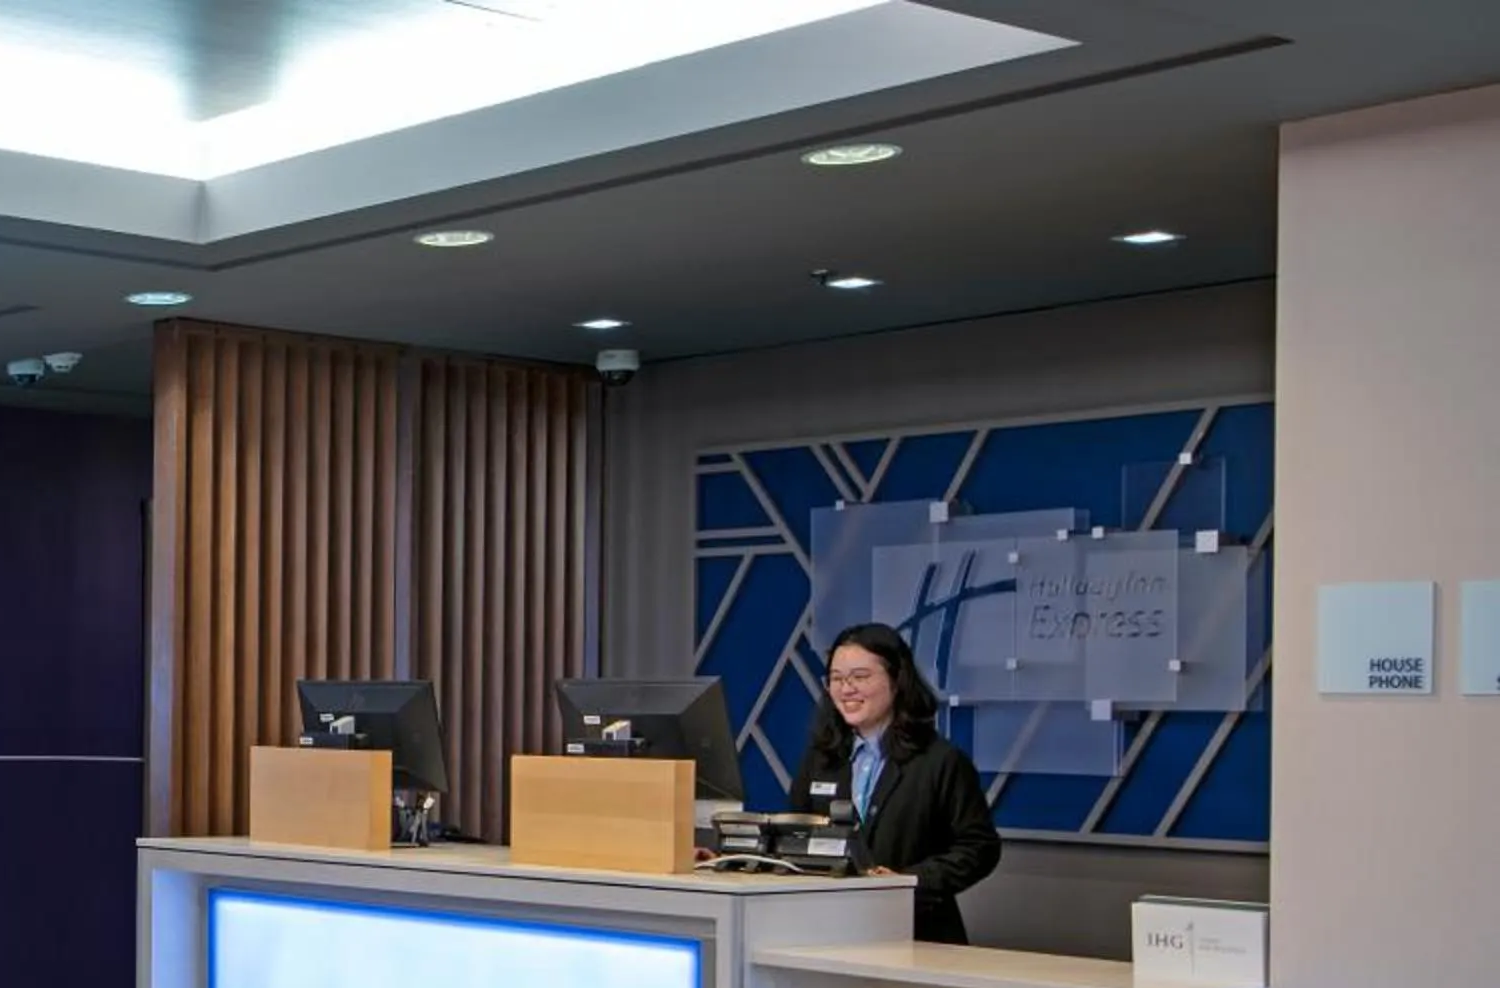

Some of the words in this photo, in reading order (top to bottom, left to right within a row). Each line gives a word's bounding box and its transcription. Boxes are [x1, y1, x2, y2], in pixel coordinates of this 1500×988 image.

[1029, 604, 1164, 640] Express
[1369, 657, 1424, 673] HOUSE
[1368, 674, 1424, 690] PHONE
[1147, 932, 1184, 950] IHG
